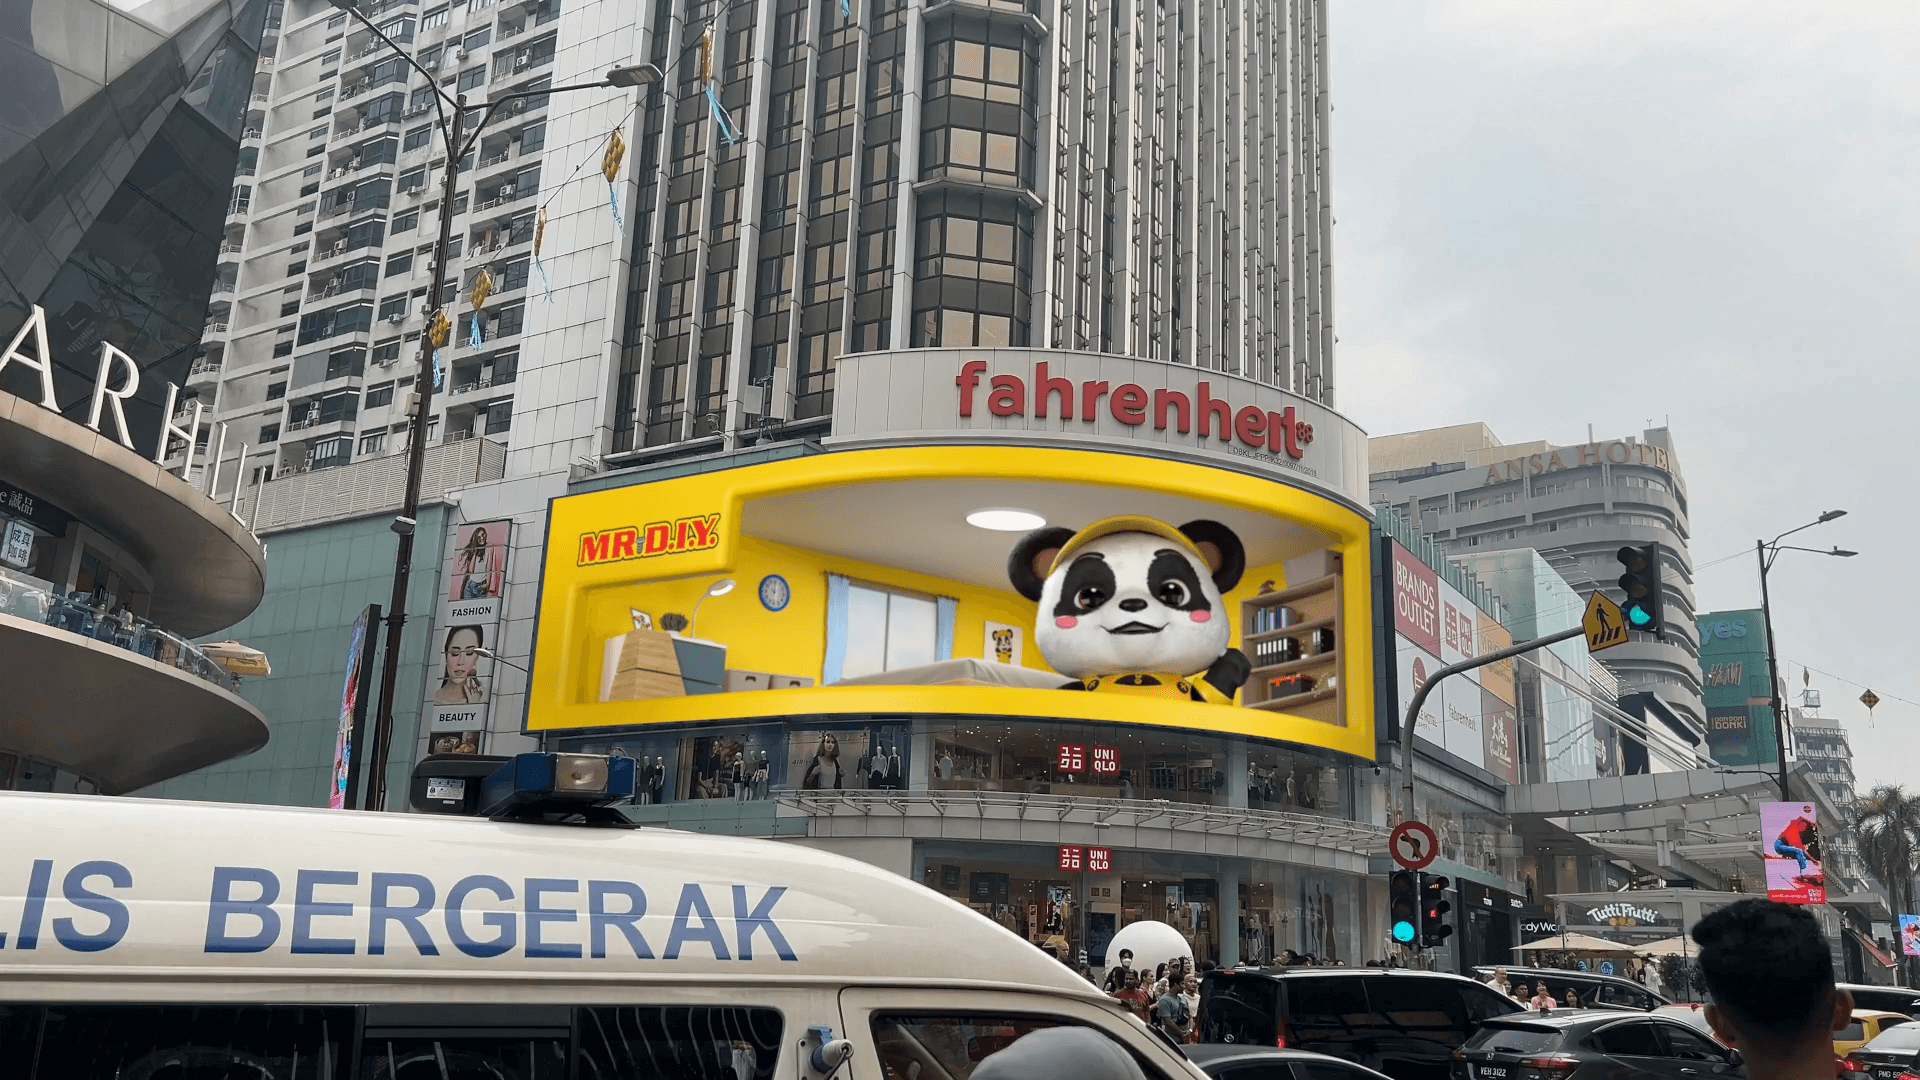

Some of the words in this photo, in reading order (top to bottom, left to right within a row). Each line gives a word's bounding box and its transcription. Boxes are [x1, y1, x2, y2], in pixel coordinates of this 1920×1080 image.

[1483, 450, 1567, 486] ANSA
[1576, 441, 1674, 475] HOTEL
[1396, 560, 1435, 611] BRANDS
[452, 606, 492, 617] FASHION
[1398, 591, 1435, 637] OUTLET
[1460, 617, 1471, 638] UNI
[1699, 619, 1747, 646] yes
[439, 713, 477, 722] BEAUTY
[1094, 749, 1114, 760] UNI
[1094, 761, 1116, 772] QLO
[1090, 850, 1107, 860] UNI
[1090, 860, 1109, 870] QLO
[0, 859, 134, 952] IS
[204, 866, 799, 962] BERGERAK
[1586, 903, 1620, 923] Tutti
[1620, 903, 1659, 924] Frutti
[1519, 921, 1540, 933] ody
[1480, 1066, 1492, 1076] VEH
[1492, 1067, 1507, 1077] 3122
[1878, 1069, 1891, 1078] PMG
